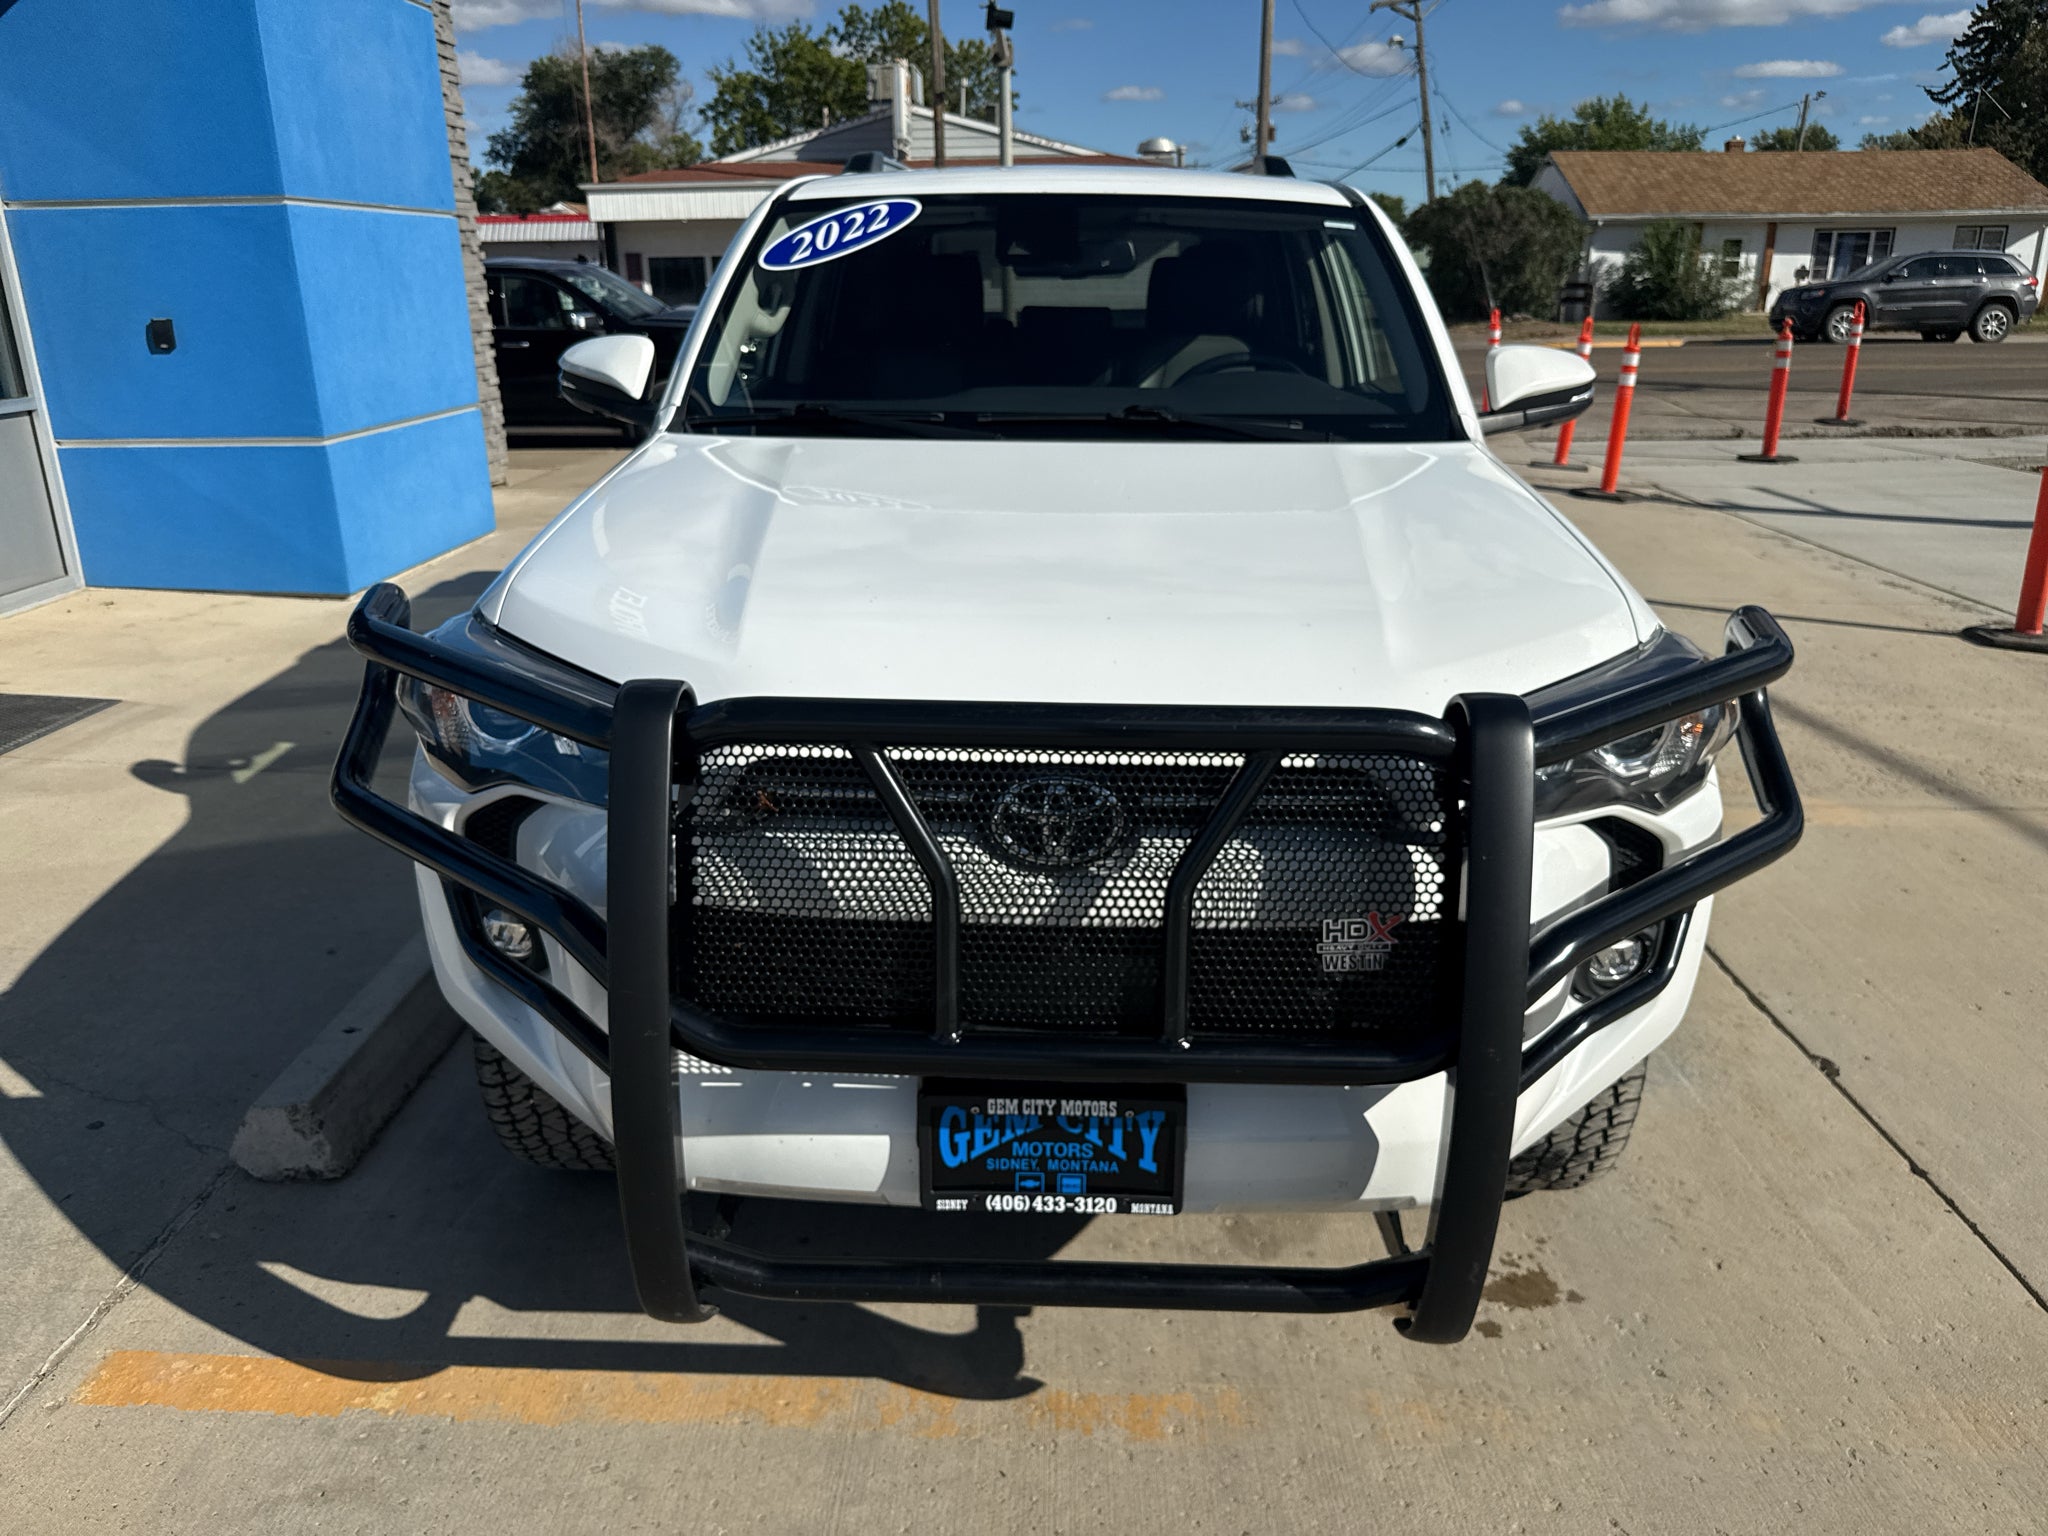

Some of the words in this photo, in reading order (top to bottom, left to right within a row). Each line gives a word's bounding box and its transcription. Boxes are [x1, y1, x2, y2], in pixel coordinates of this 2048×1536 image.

[789, 203, 890, 264] 2022
[1322, 911, 1405, 943] HDX
[987, 1098, 1019, 1115] GEM
[1022, 1099, 1057, 1116] CITY
[1060, 1100, 1117, 1118] MOTORS
[939, 1105, 1044, 1169] GEM
[1012, 1141, 1094, 1158] MOTORS
[1047, 1159, 1119, 1173] MONTANA
[936, 1199, 968, 1211] SIDNEY
[1130, 1203, 1174, 1215] MONTANA
